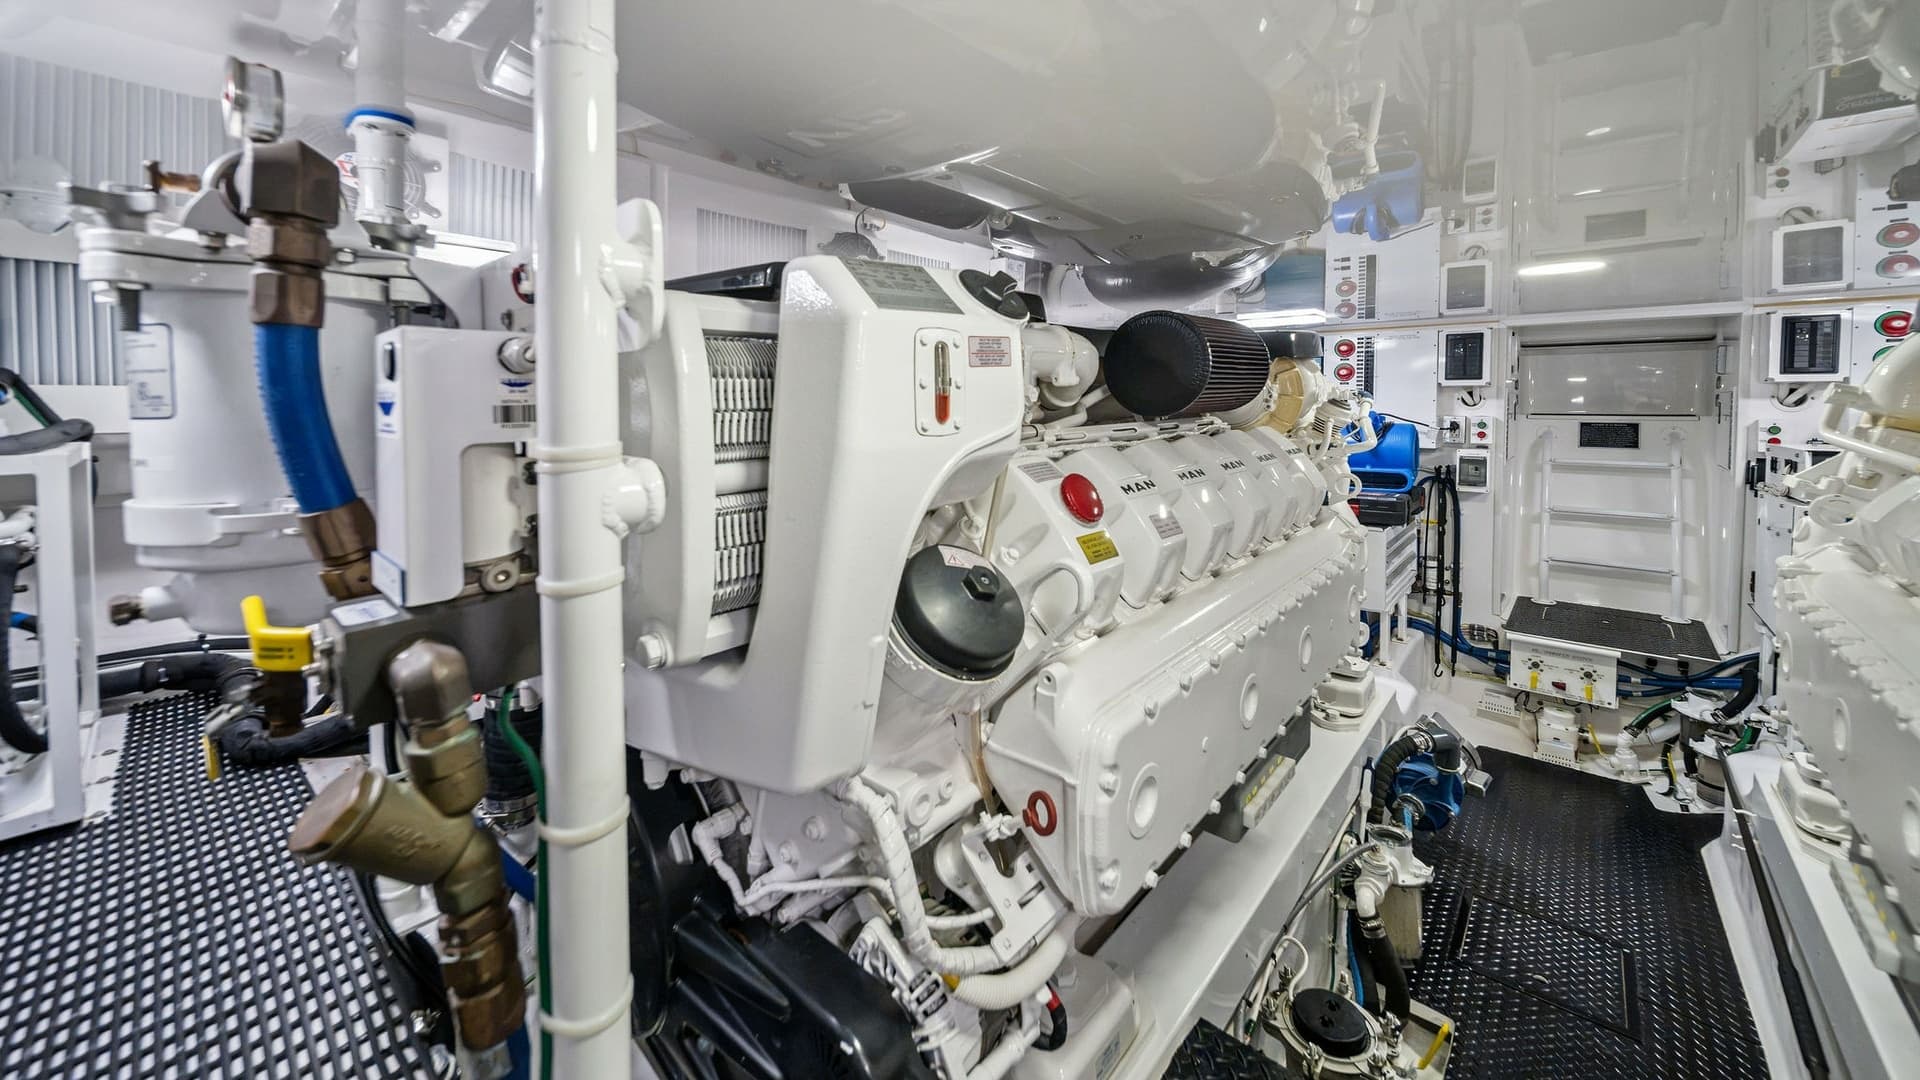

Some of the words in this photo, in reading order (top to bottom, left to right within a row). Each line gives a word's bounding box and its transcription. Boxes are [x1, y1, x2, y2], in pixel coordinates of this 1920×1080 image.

[1257, 453, 1278, 463] MAN
[1220, 460, 1245, 471] MAN
[1177, 468, 1206, 481] MAN
[1120, 479, 1156, 495] MAN
